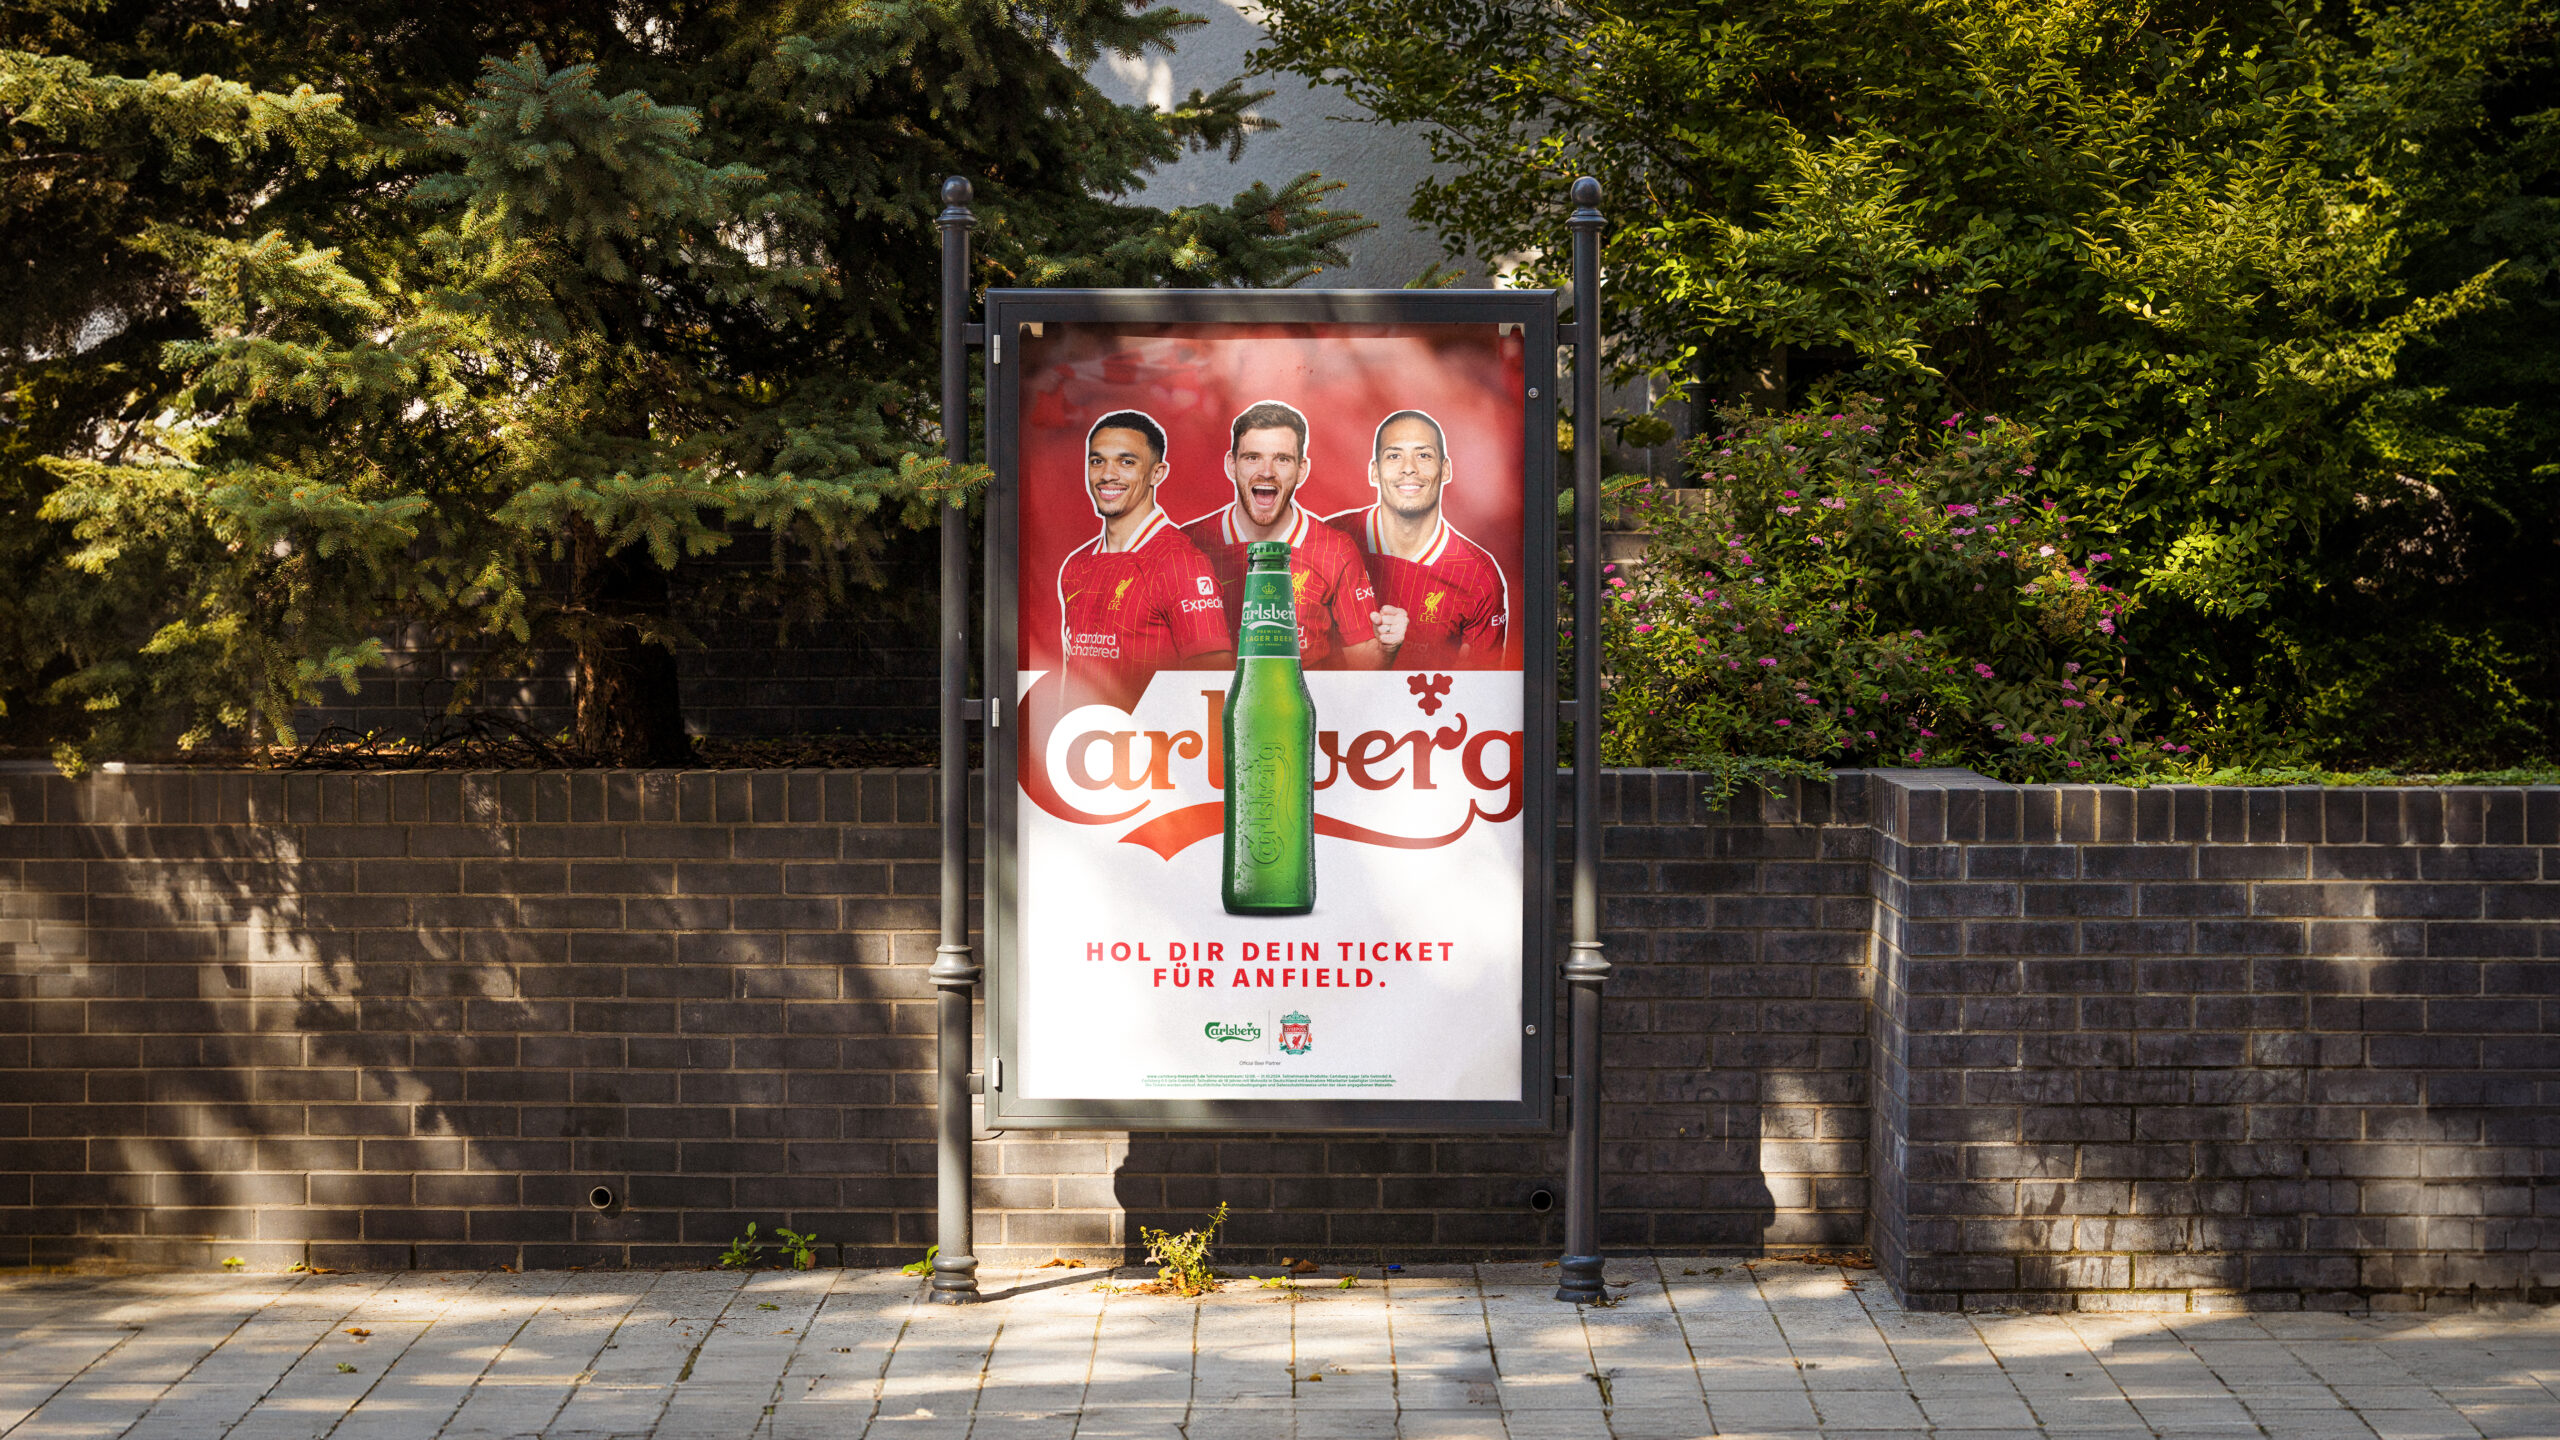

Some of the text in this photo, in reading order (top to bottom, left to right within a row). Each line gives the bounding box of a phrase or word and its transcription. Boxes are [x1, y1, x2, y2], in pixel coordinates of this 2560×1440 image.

[1294, 597, 1306, 605] FC
[1245, 635, 1271, 643] LAGER
[1086, 942, 1454, 962] HOL DIR DEIN TICKET
[1153, 962, 1387, 988] FÜR ANFIELD.
[1204, 1021, 1261, 1042] Carlsberg
